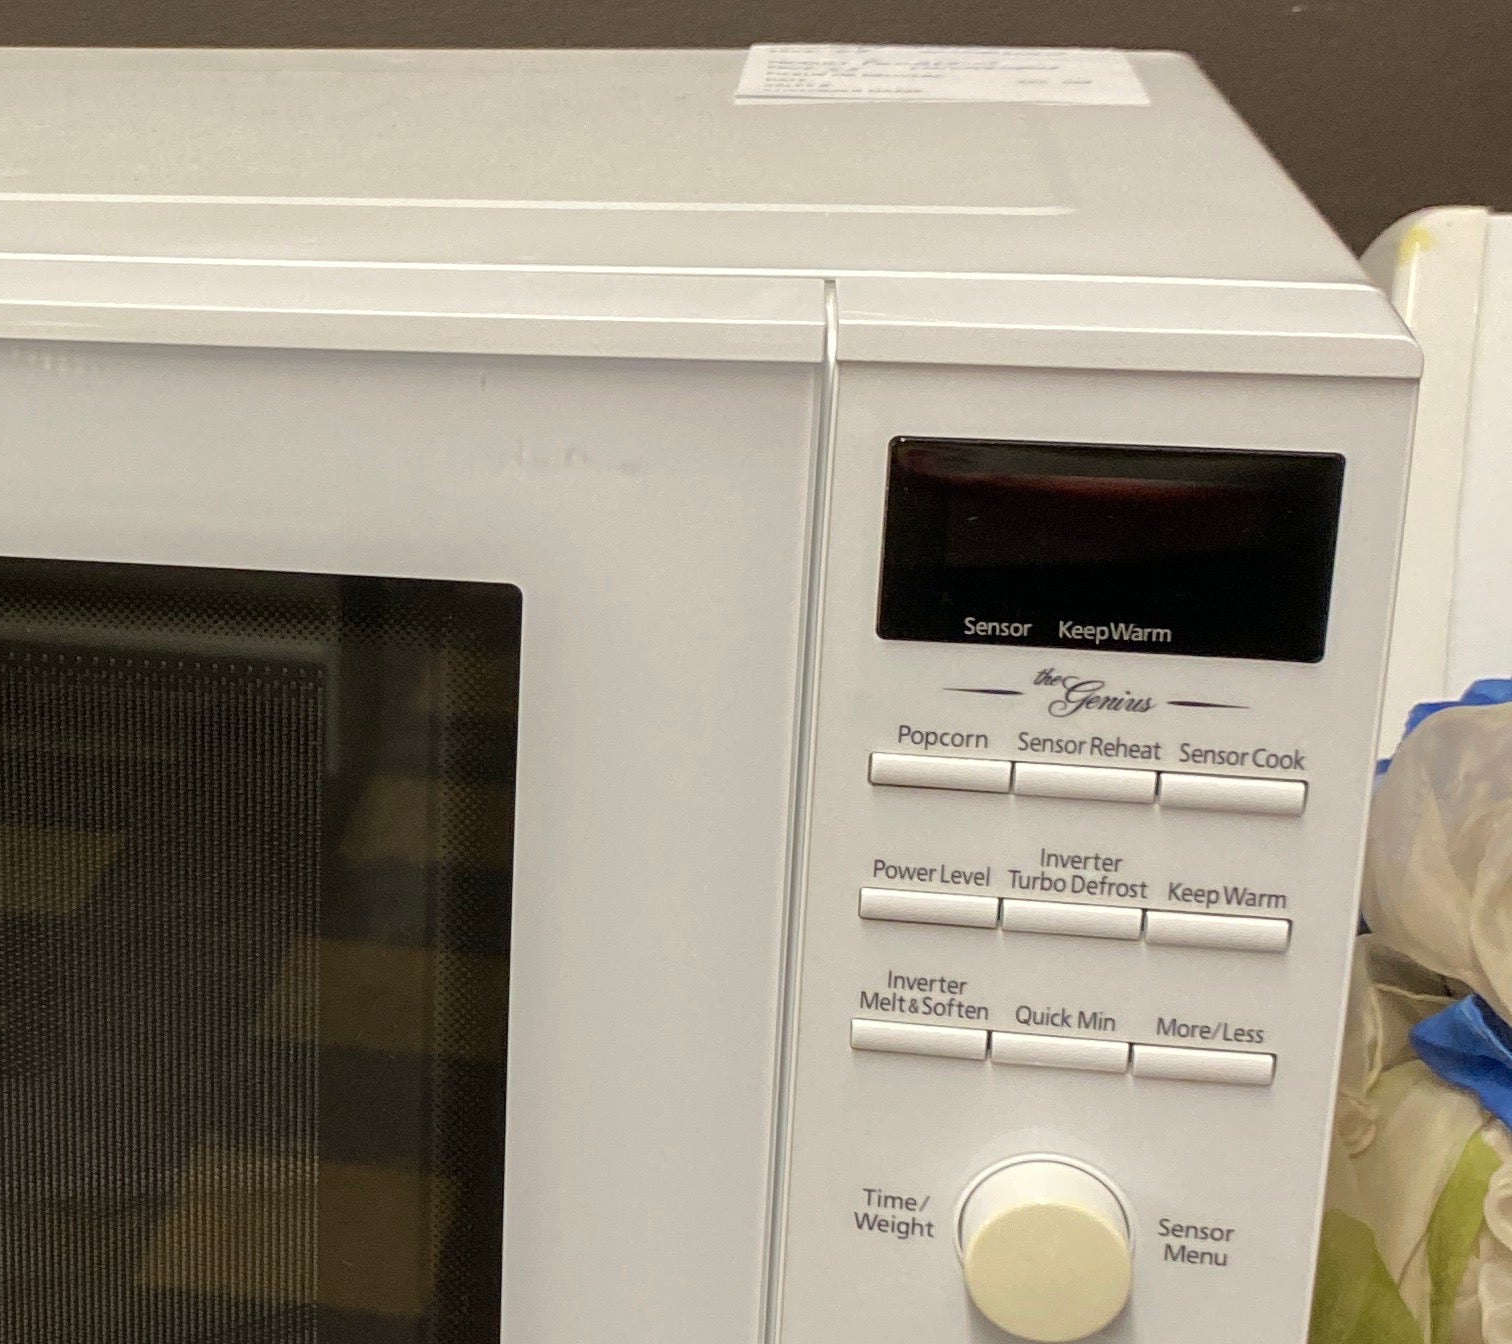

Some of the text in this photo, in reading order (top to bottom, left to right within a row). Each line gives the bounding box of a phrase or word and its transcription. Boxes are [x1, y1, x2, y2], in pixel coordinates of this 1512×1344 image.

[963, 616, 1033, 638] Sensor
[1032, 667, 1158, 718] the Genius
[898, 725, 989, 752] Popcorn
[1018, 732, 1162, 761] Sensor Reheat
[1180, 743, 1306, 771] Sensor Cook
[873, 860, 991, 888] Power Level
[1041, 849, 1123, 873] Inverter
[1008, 870, 1149, 900] Turbo Defrost
[1168, 883, 1288, 910] Keep Warm
[888, 970, 968, 995] Inverter
[1016, 1005, 1116, 1032] Quick Min
[1156, 1017, 1265, 1045] More/Less
[862, 1187, 931, 1212] Time/
[854, 1211, 936, 1240] Weight
[1158, 1217, 1236, 1244] Sensor
[1163, 1243, 1229, 1268] Menu
